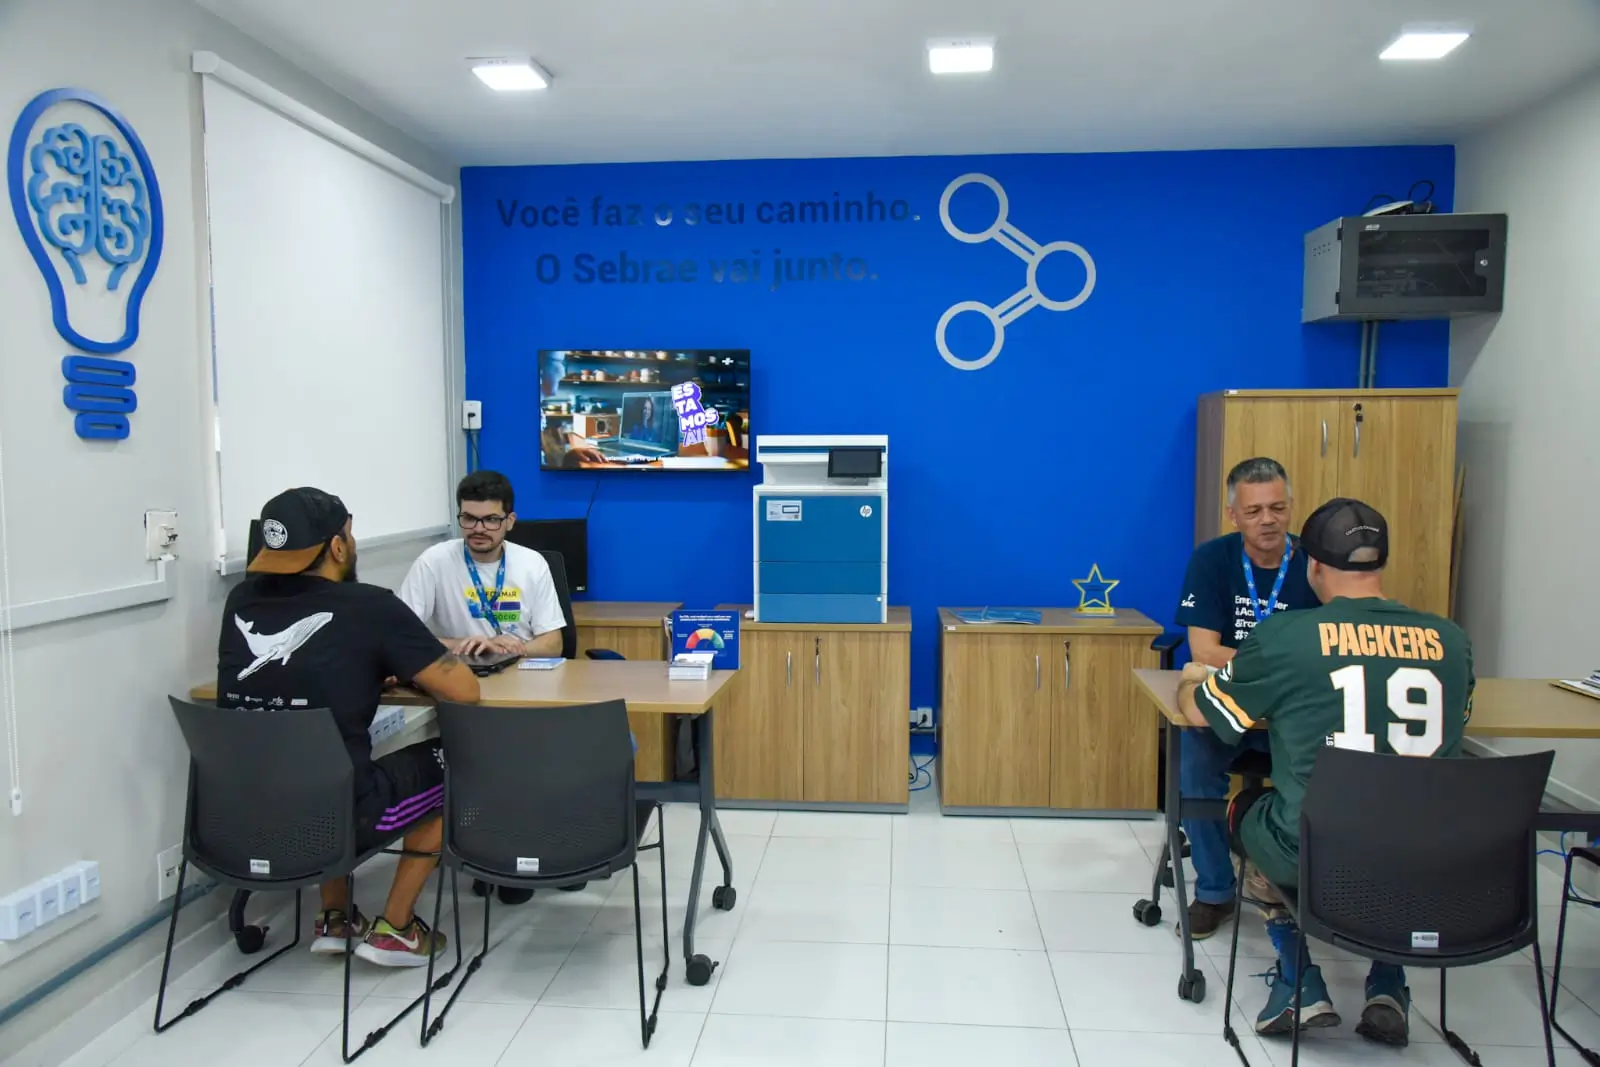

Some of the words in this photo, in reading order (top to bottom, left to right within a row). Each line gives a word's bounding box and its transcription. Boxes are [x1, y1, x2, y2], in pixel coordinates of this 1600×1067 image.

[496, 197, 580, 227] Você
[590, 196, 645, 227] faz
[654, 202, 673, 226] o
[683, 201, 745, 226] seu
[756, 191, 920, 225] caminho.
[536, 253, 561, 285] O
[573, 250, 698, 285] Sebrae
[708, 249, 761, 283] vai
[768, 248, 879, 292] junto.
[1318, 622, 1444, 661] PACKERS
[1329, 664, 1443, 757] 19
